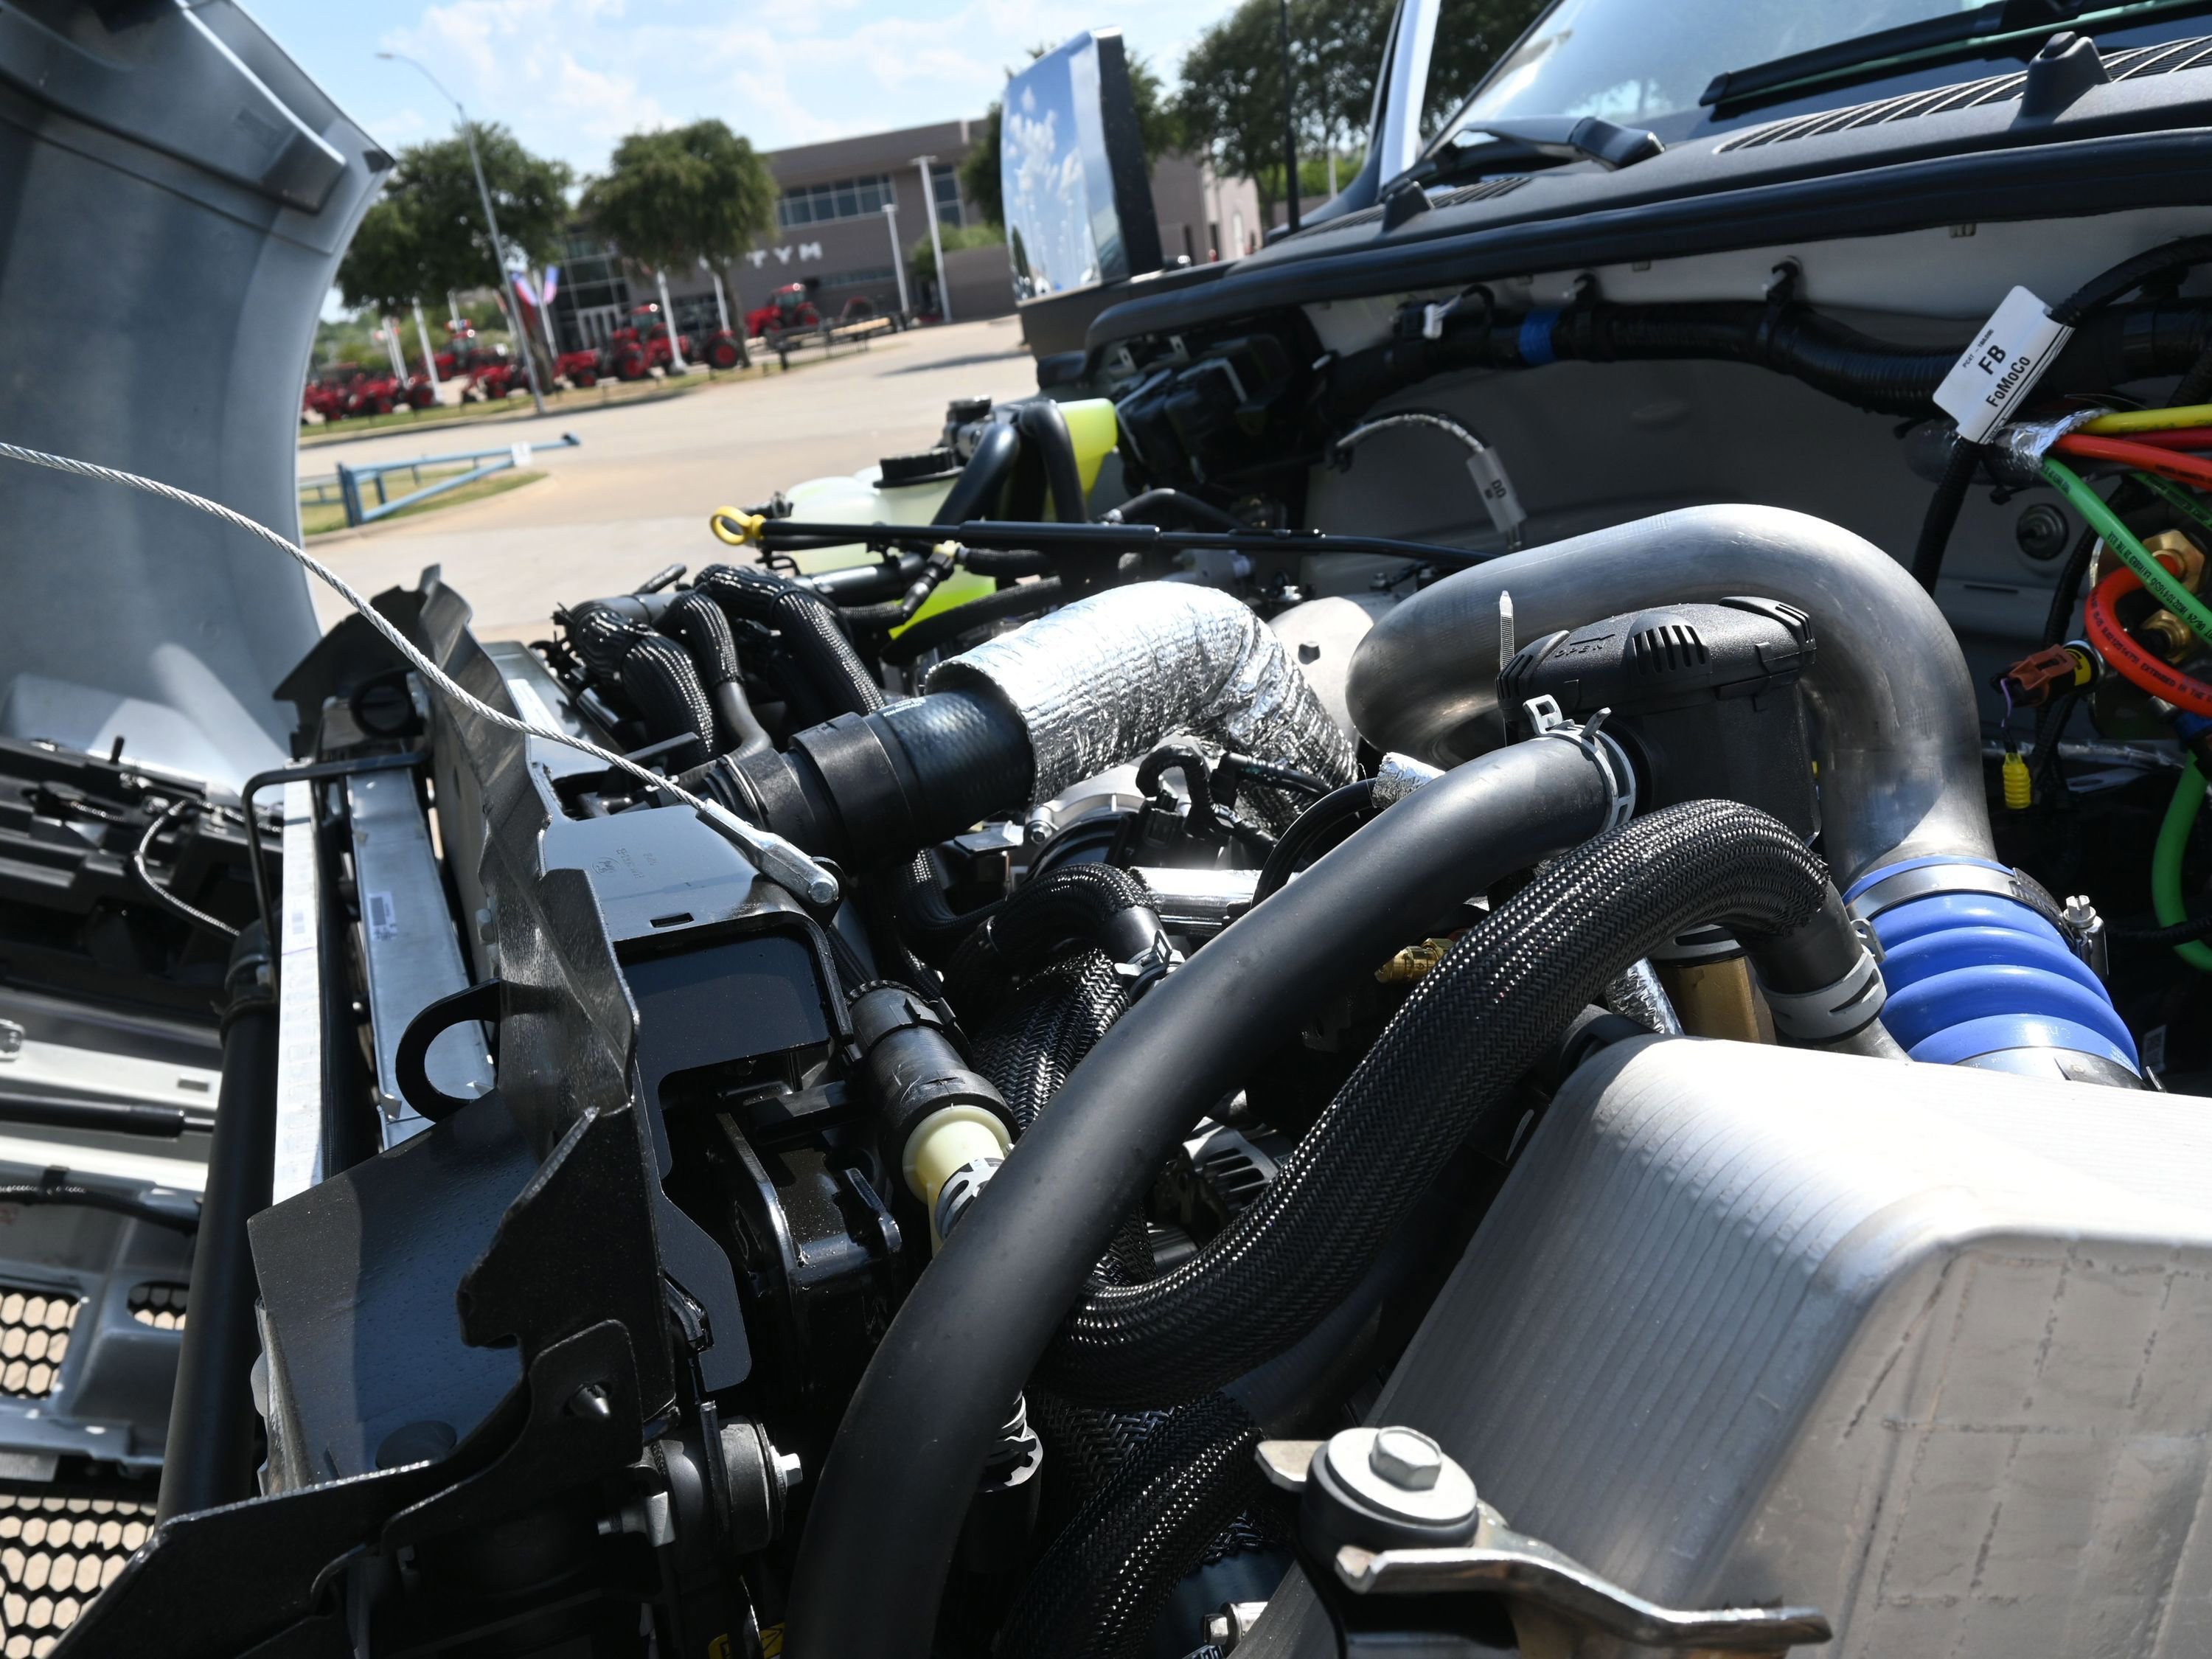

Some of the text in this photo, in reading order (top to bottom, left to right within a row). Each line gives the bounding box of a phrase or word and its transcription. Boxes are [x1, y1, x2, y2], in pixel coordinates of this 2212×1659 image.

[745, 241, 824, 268] TYM
[1978, 344, 2006, 375] FB
[1986, 356, 2031, 407] FoMoCo
